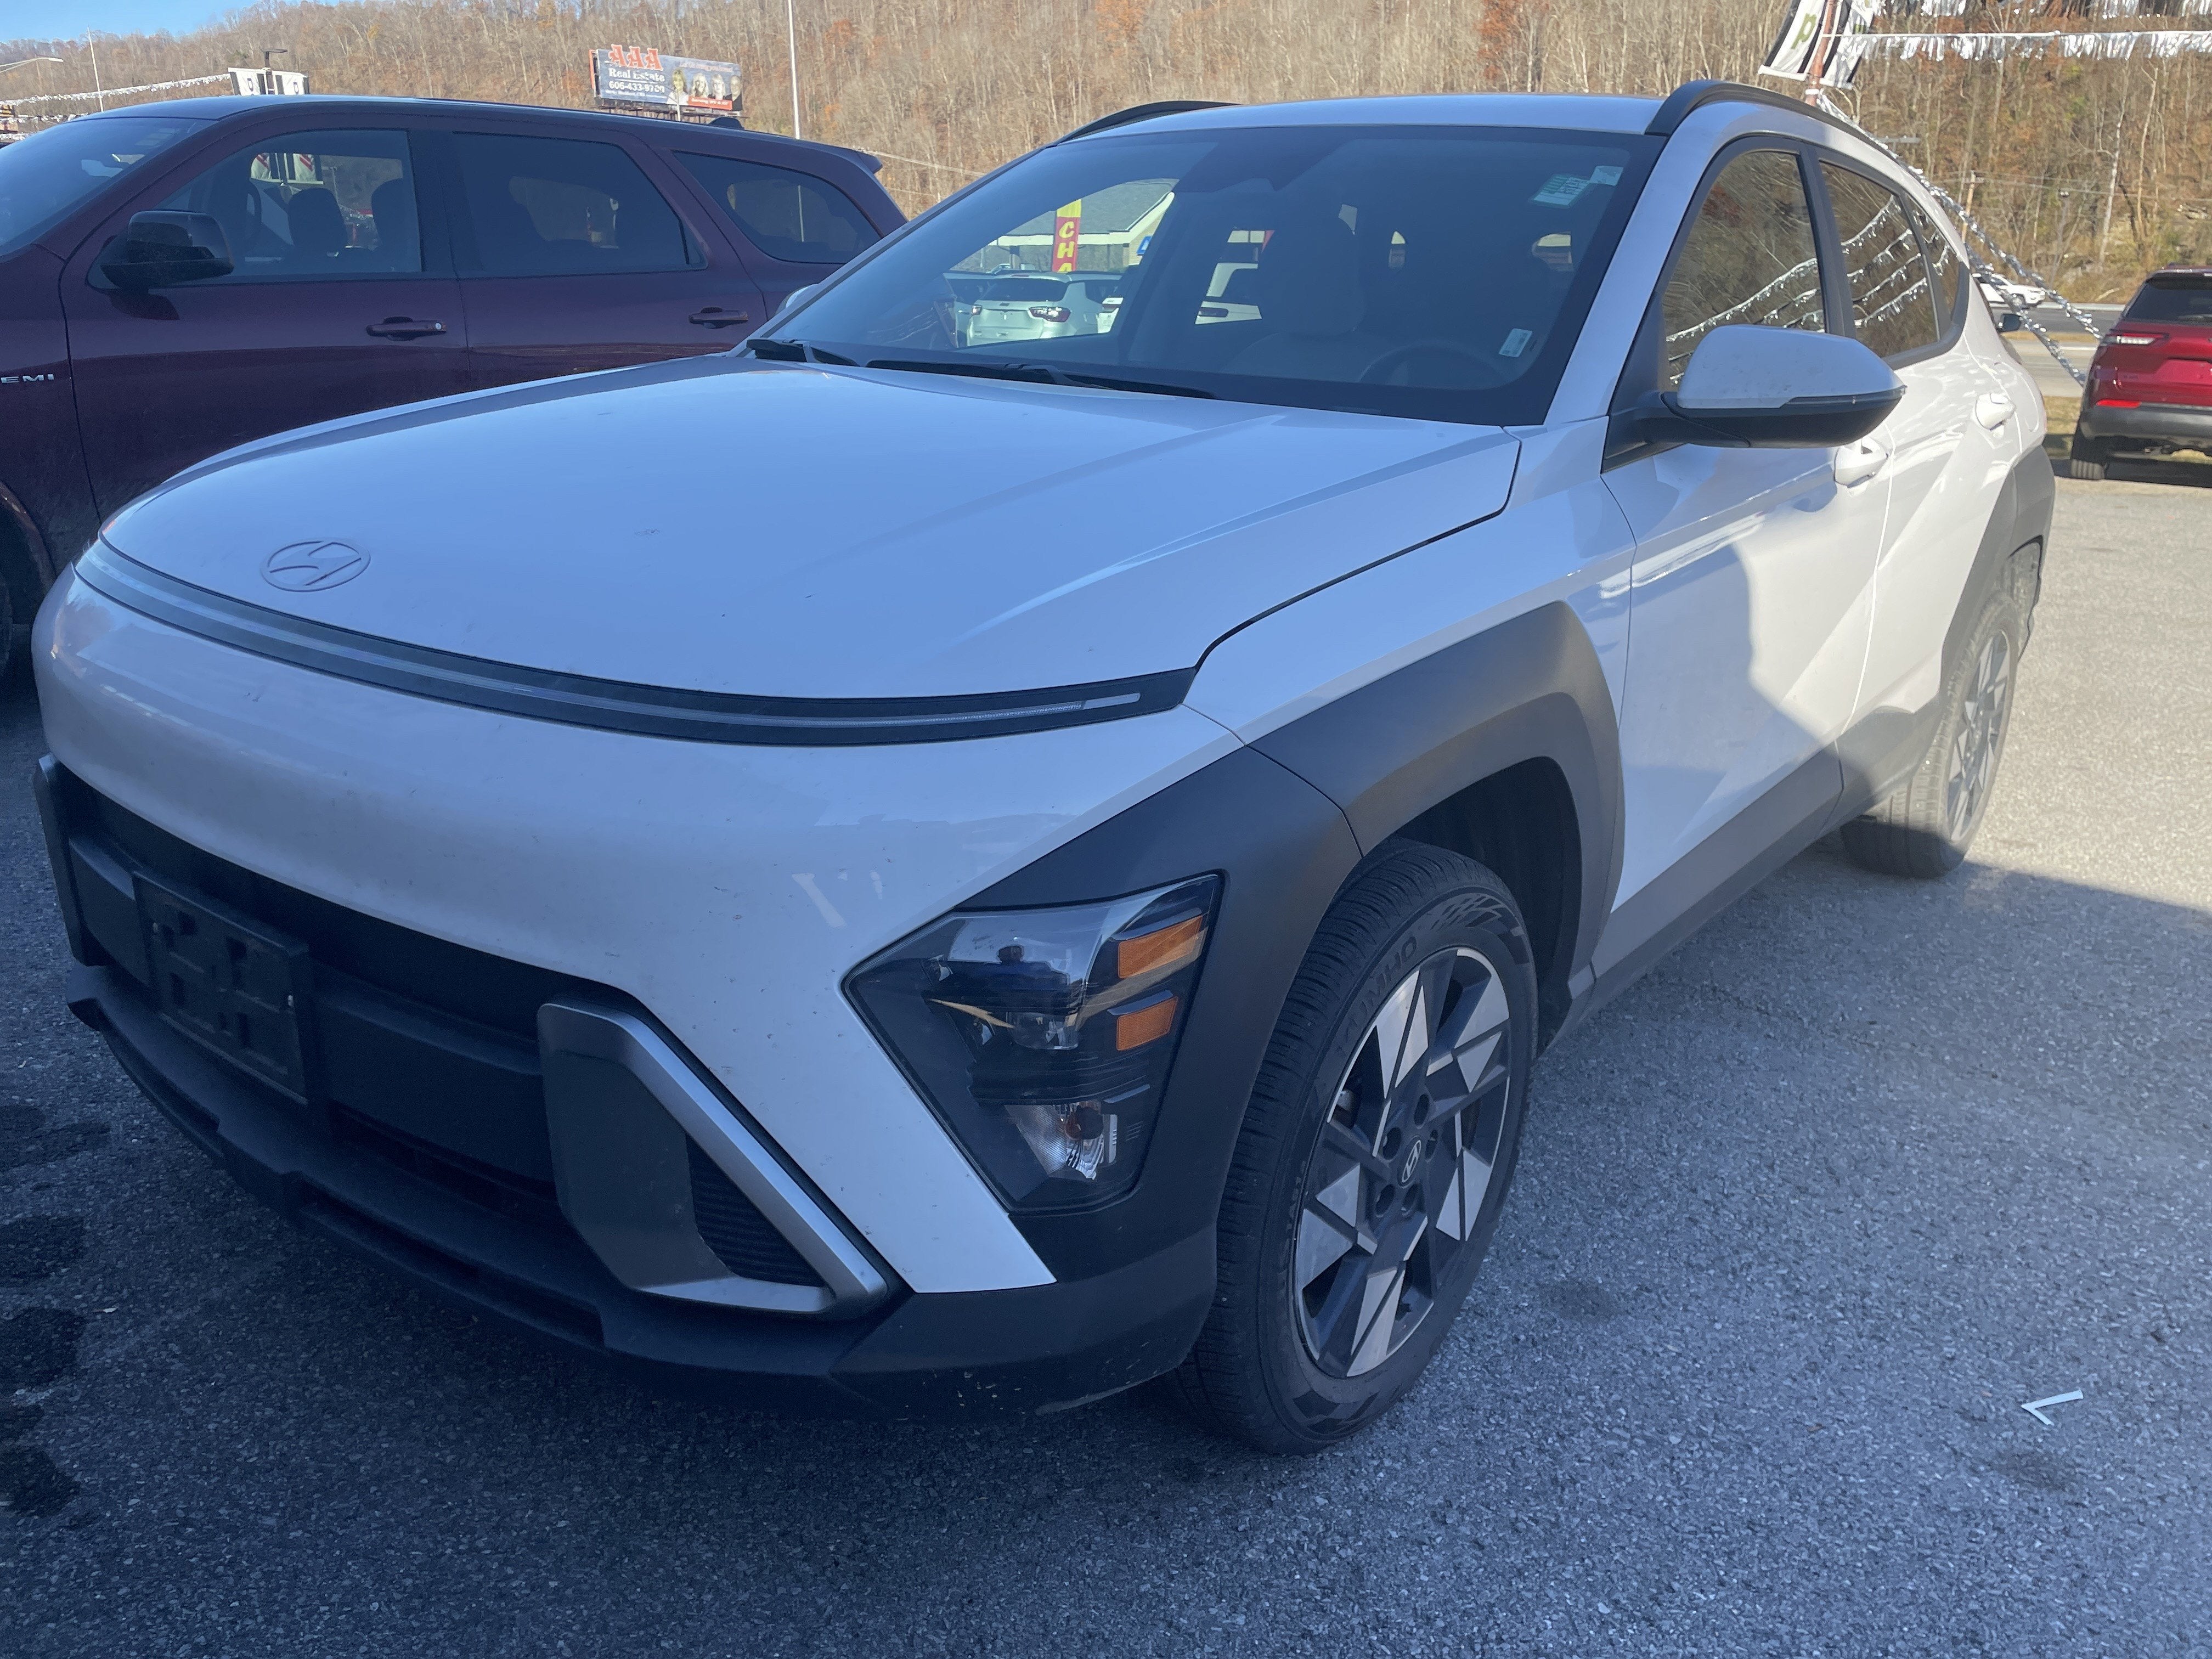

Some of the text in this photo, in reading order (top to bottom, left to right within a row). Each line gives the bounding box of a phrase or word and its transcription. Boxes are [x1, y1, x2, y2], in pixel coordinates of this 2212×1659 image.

[608, 44, 663, 71] AAA
[608, 67, 665, 82] Real Estate
